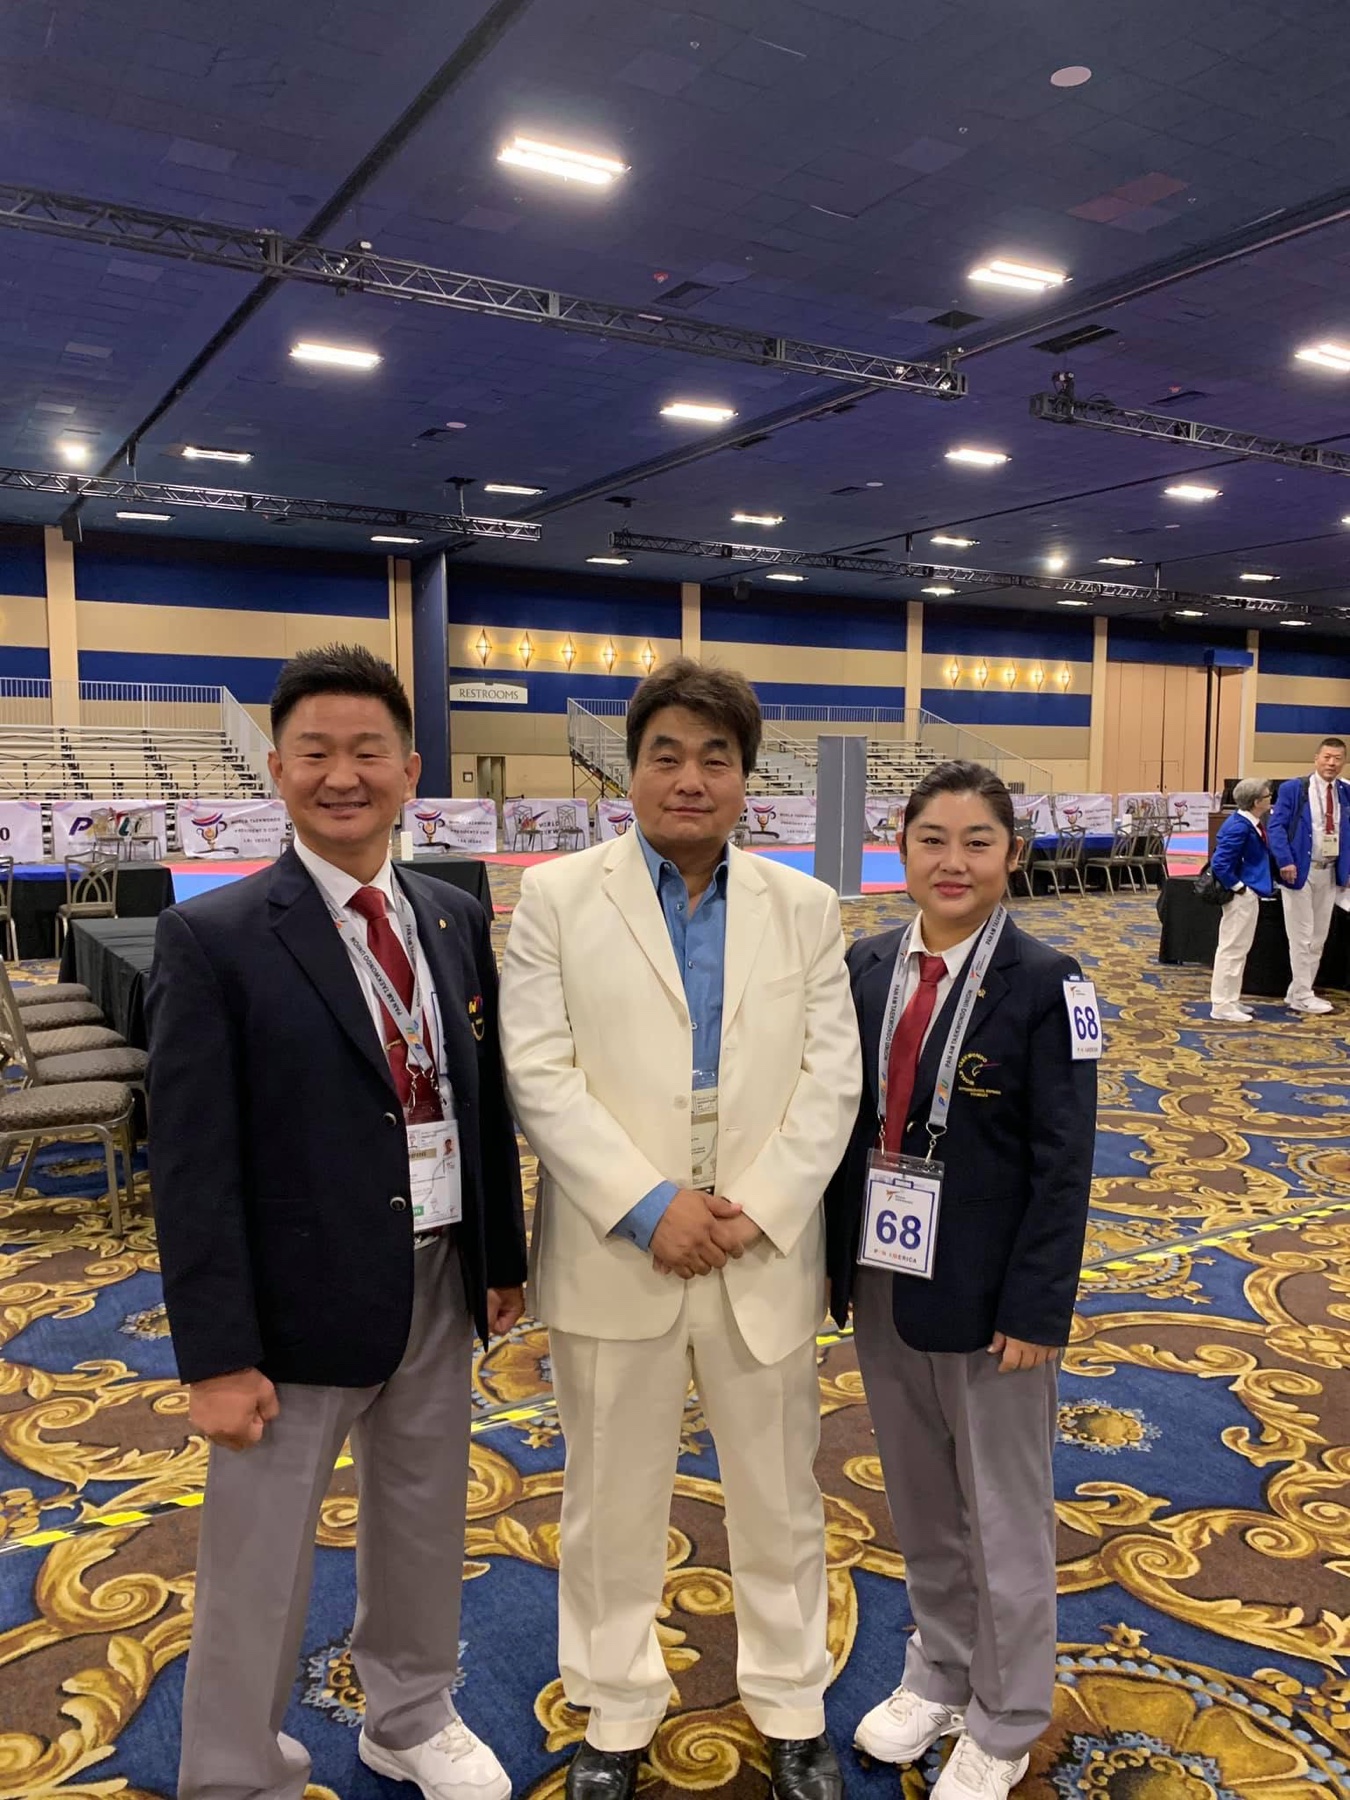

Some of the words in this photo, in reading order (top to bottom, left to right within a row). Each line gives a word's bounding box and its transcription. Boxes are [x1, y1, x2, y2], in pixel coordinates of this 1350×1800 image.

[459, 688, 519, 700] RESTROOMS
[363, 954, 390, 993] TAEKWONDO
[391, 1002, 403, 1017] PAN
[1074, 1006, 1098, 1040] 68
[944, 1054, 954, 1069] PAN
[950, 1007, 968, 1045] TAEKWONDO
[876, 1210, 921, 1250] 68
